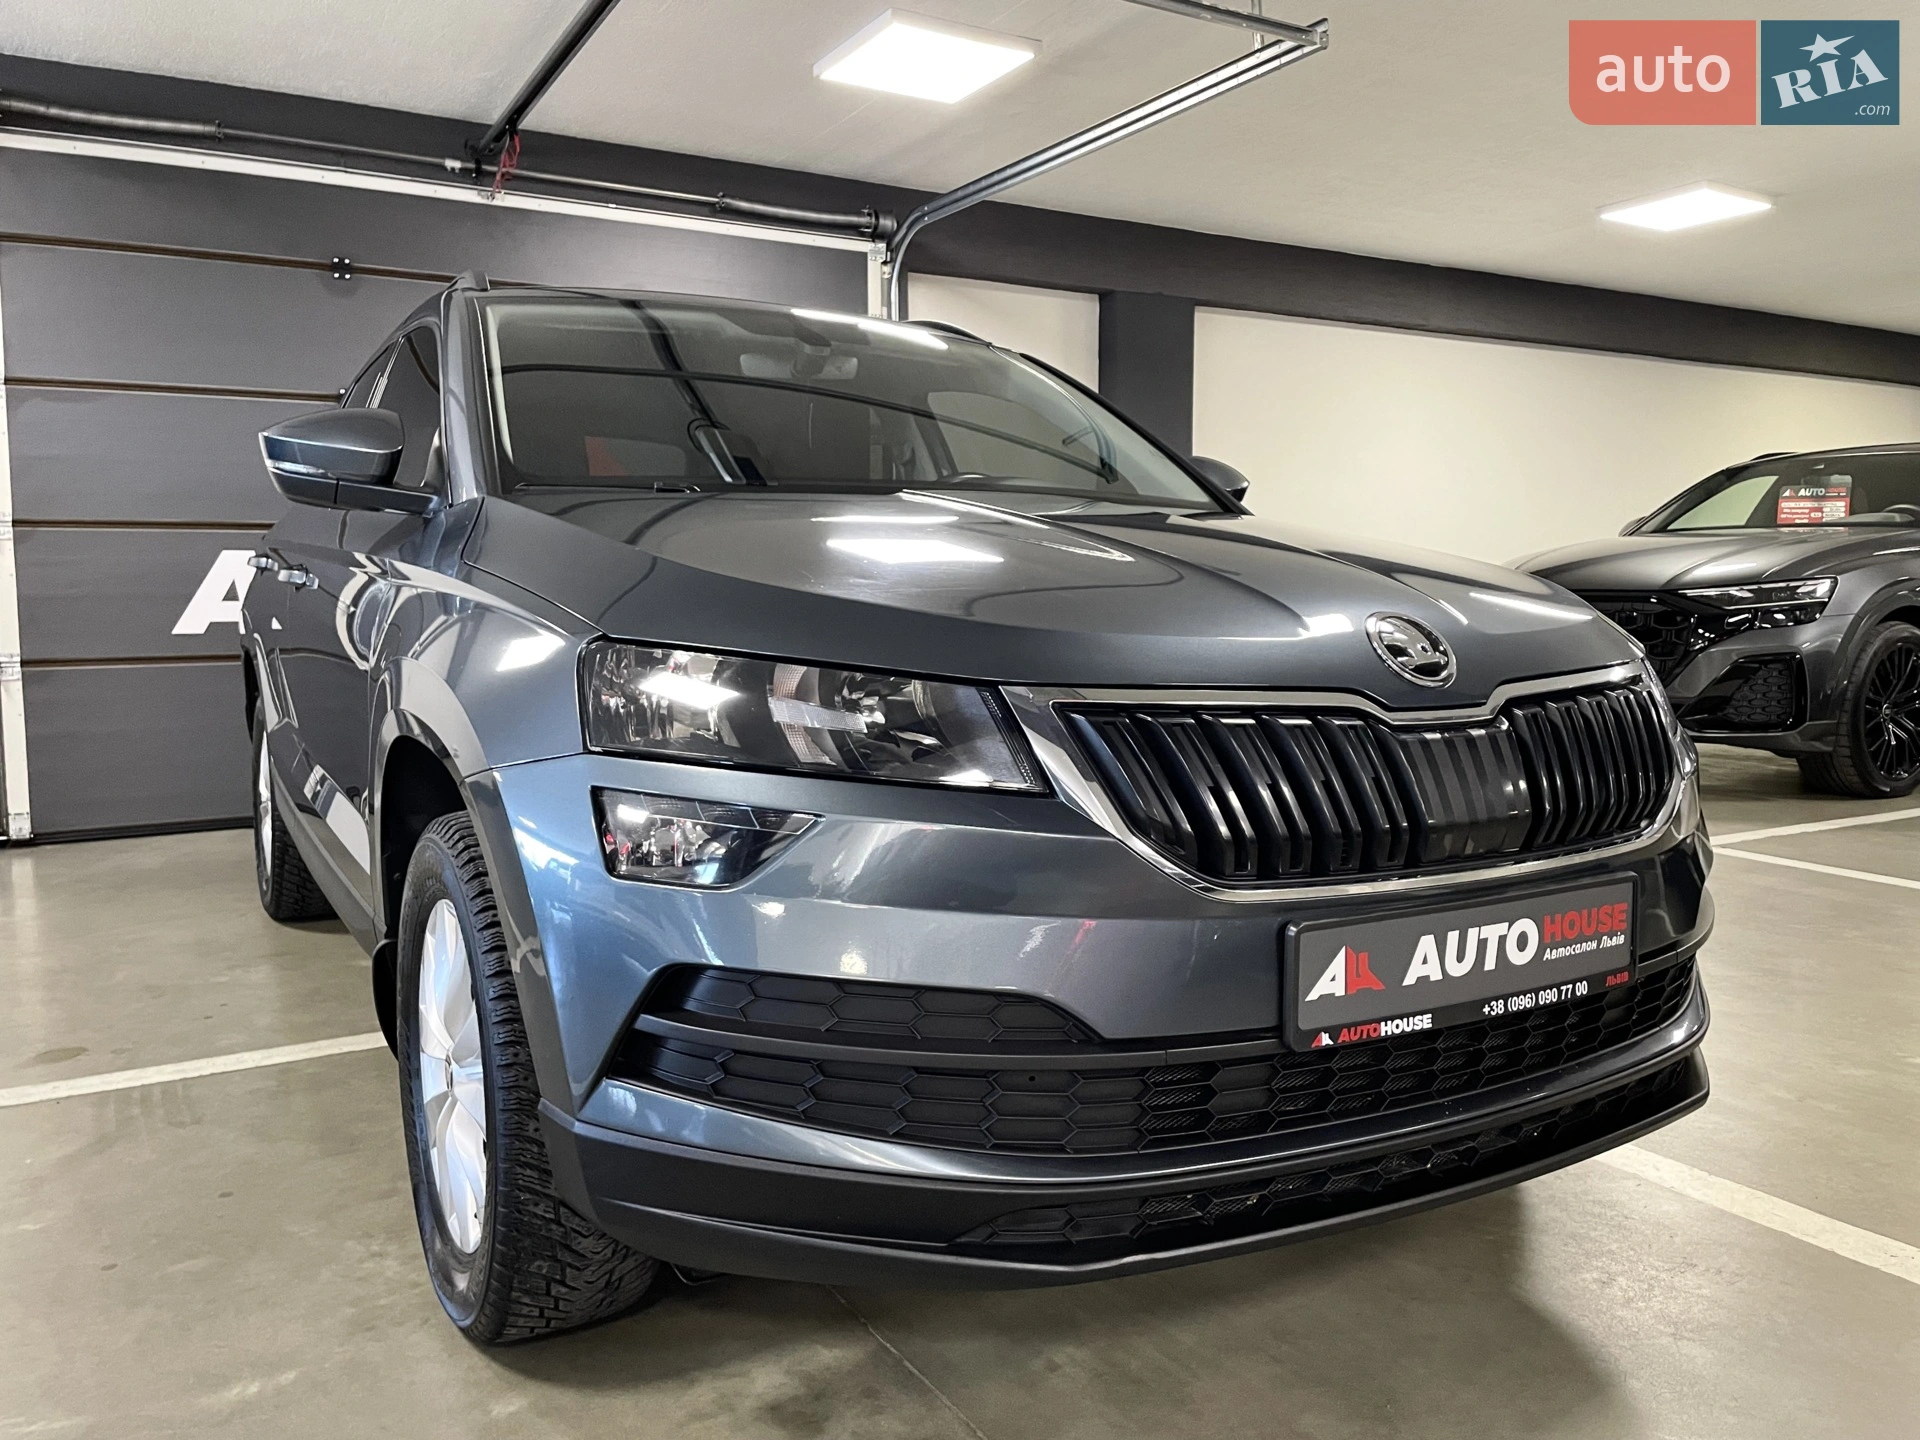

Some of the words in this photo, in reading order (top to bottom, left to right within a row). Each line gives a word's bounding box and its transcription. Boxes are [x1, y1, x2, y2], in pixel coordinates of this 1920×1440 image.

[1797, 488, 1825, 496] AUTO
[1402, 917, 1539, 987] AUTO
[1543, 902, 1628, 944] HOUSE
[1543, 939, 1598, 961] Автосалон
[1599, 931, 1625, 949] Львів
[1482, 999, 1505, 1016] +38
[1507, 992, 1536, 1012] (096)
[1538, 987, 1558, 1005] 090
[1560, 983, 1573, 999] 77
[1575, 980, 1589, 997] 00
[1337, 1013, 1433, 1044] AUTOHOUSE
